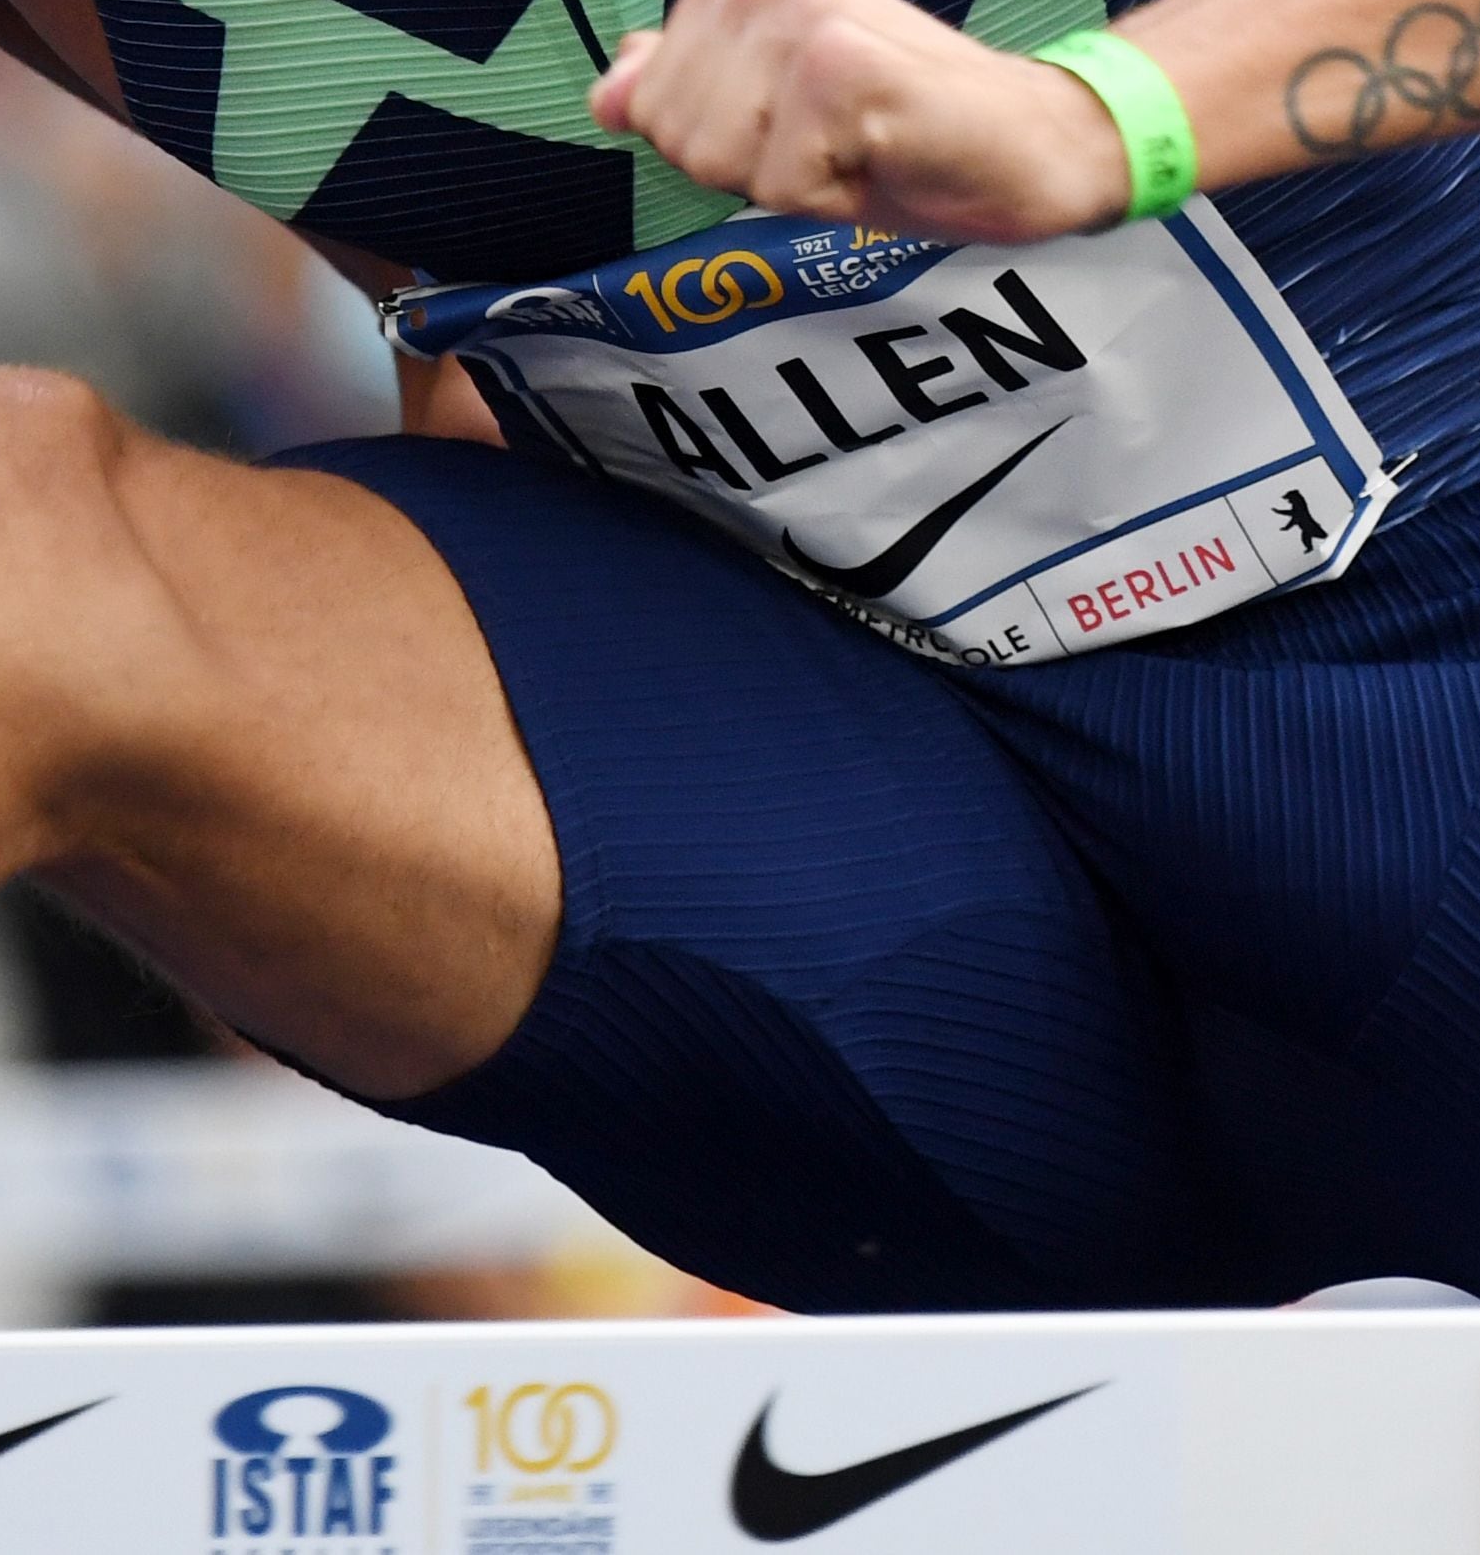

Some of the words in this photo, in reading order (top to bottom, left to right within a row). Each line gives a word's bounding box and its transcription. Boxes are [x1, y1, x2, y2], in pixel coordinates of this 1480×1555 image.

[794, 238, 832, 256] 1921
[849, 225, 899, 249] JA
[623, 250, 785, 333] 100
[631, 269, 1087, 491] ALLEN
[1066, 536, 1236, 633] BERLIN
[464, 1382, 617, 1473] 100
[211, 1456, 395, 1537] ISTAF
